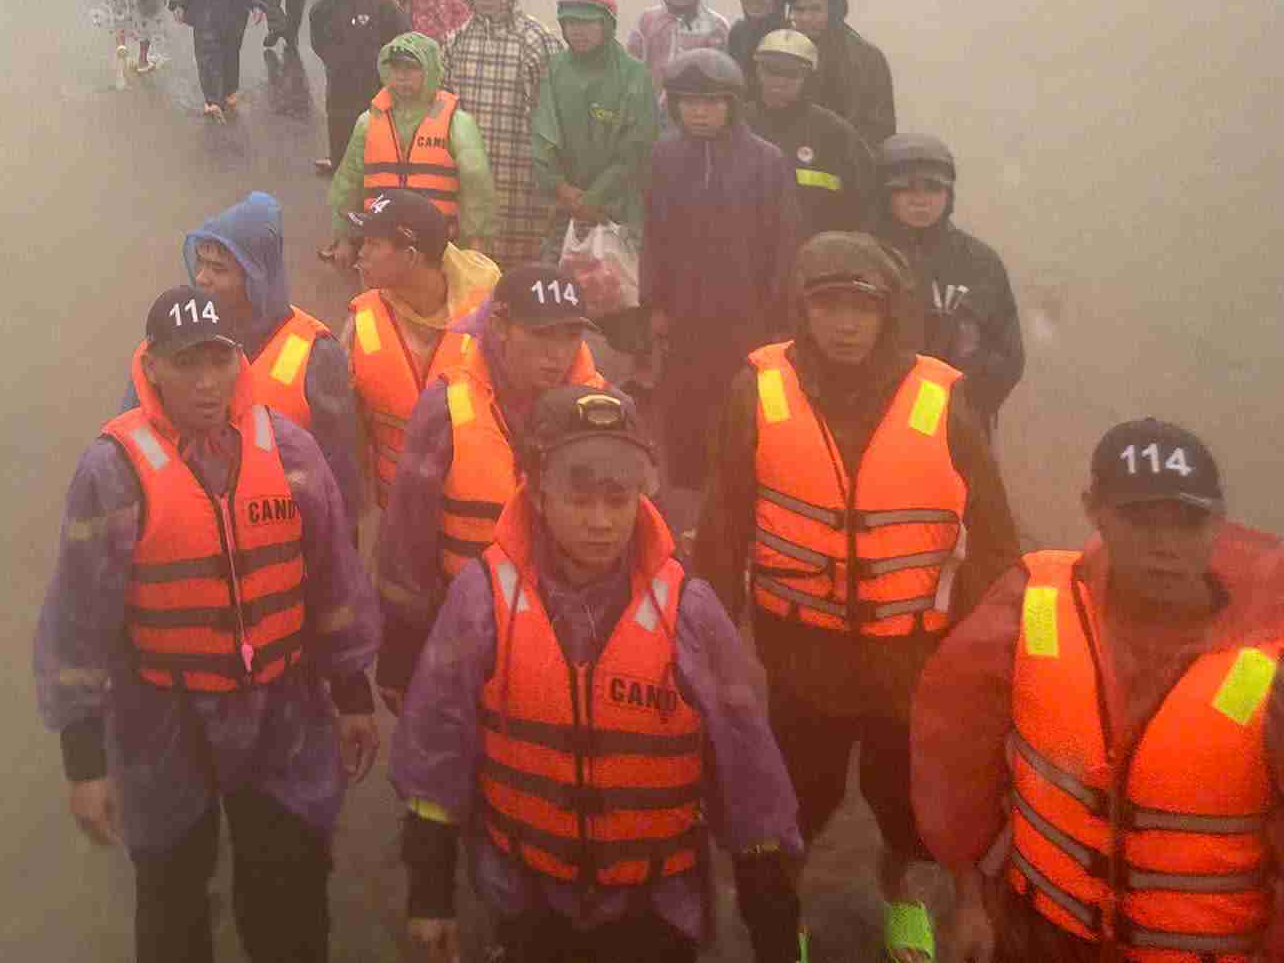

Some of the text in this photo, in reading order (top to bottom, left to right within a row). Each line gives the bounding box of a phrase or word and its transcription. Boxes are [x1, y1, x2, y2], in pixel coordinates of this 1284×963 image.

[416, 136, 447, 149] CAN
[531, 280, 579, 305] 114
[169, 299, 220, 326] 114
[1120, 443, 1192, 476] 114
